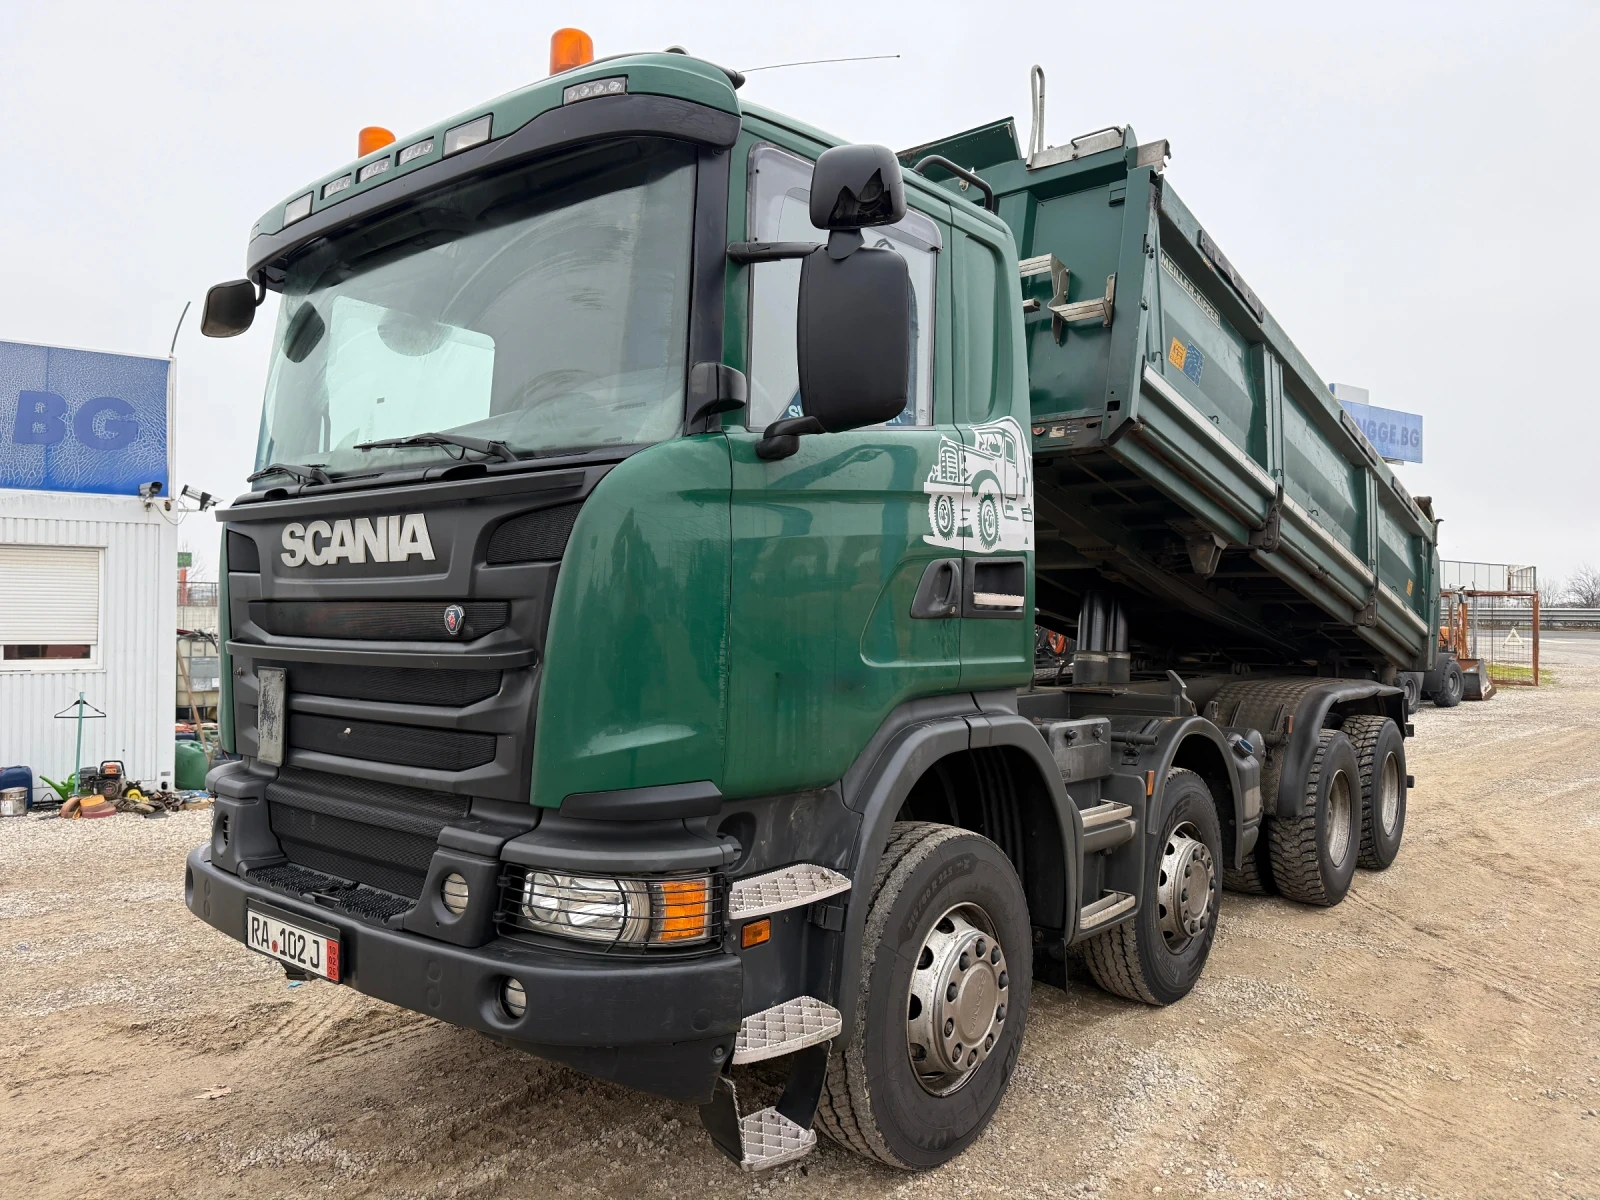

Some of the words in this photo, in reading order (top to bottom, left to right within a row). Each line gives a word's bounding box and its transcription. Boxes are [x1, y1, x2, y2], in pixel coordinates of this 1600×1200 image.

[1161, 252, 1219, 324] MEILLER-KIPPER
[13, 390, 138, 451] BG
[1353, 417, 1420, 448] NGGE.BG
[280, 512, 436, 568] SCANIA
[252, 916, 270, 950] RA
[280, 927, 306, 965] 102
[310, 940, 320, 969] J
[328, 956, 336, 966] 02
